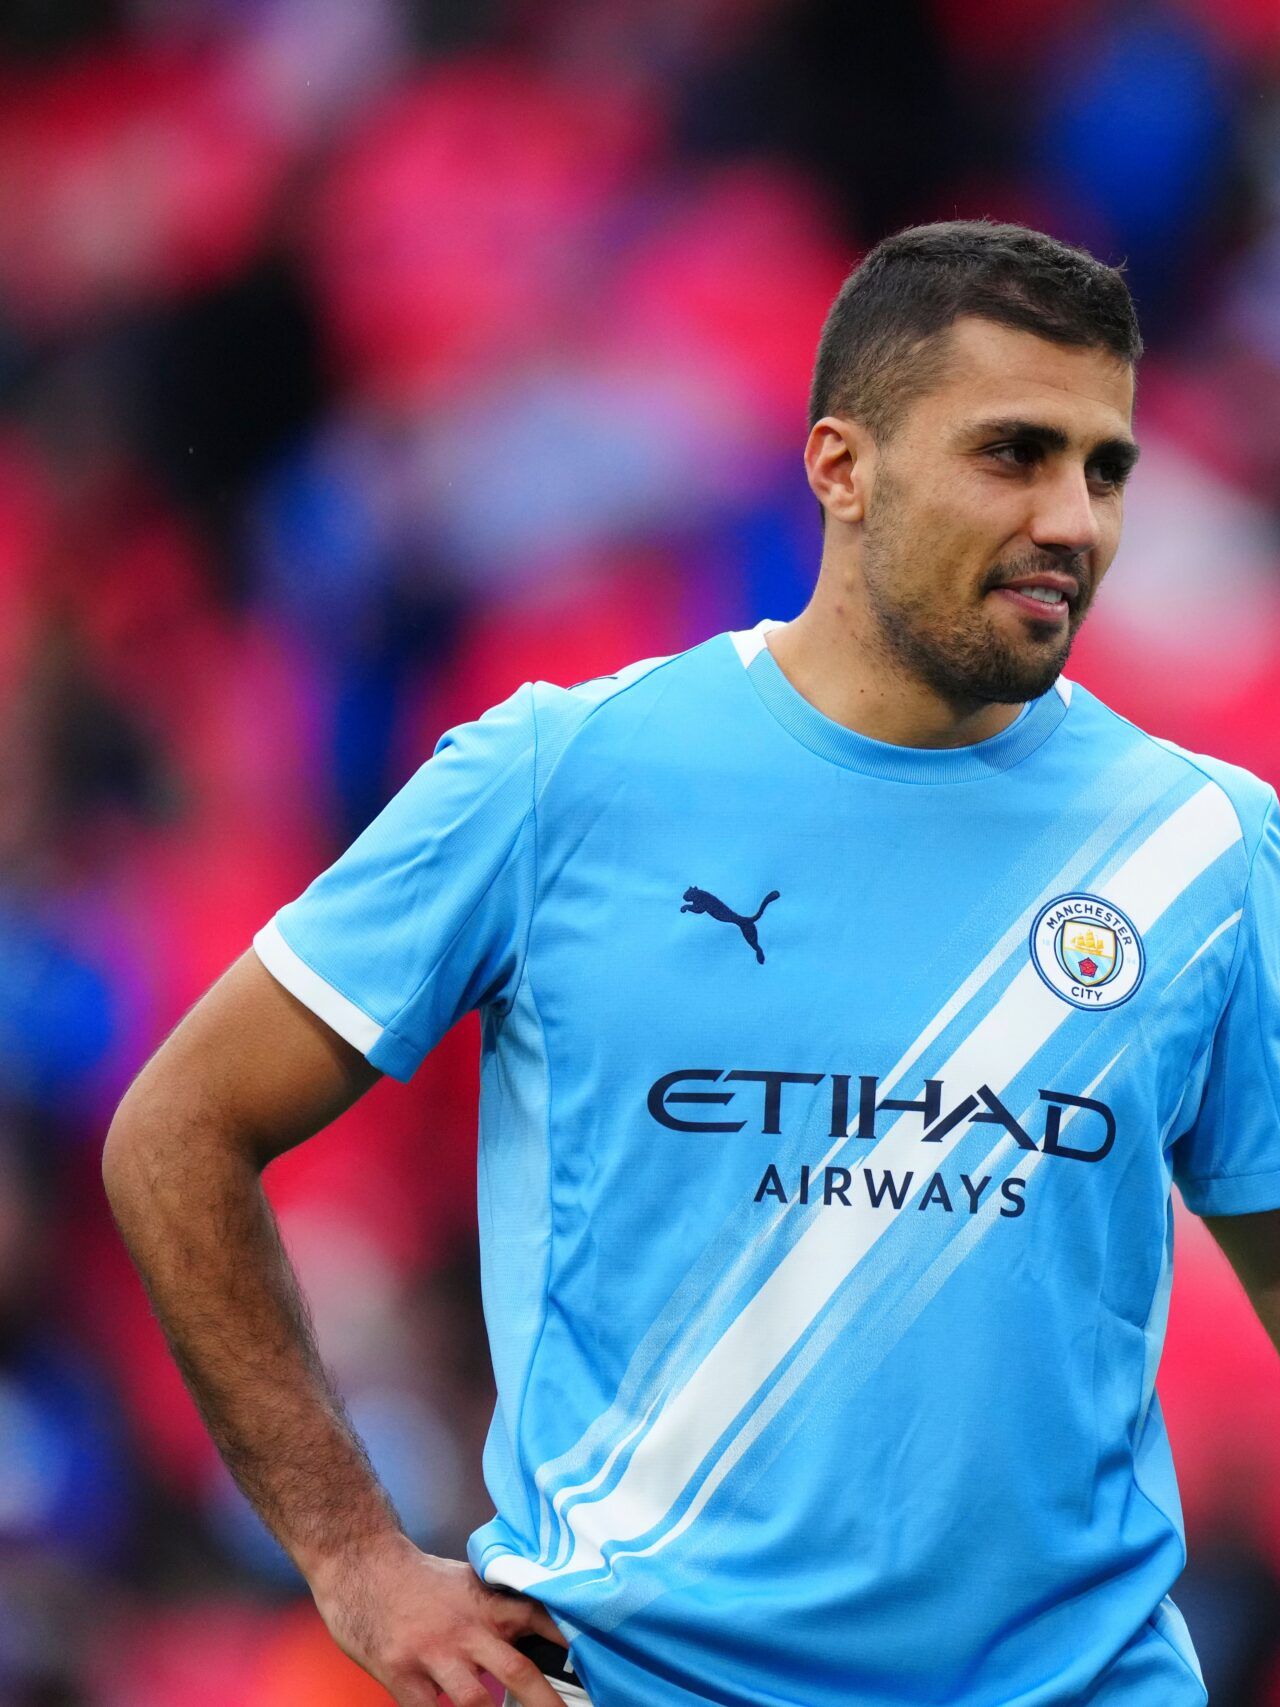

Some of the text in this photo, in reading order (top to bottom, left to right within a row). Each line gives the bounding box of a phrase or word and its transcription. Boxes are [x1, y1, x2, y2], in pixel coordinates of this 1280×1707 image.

[1047, 904, 1132, 945] MANCHESTER
[1071, 987, 1102, 1001] CITY
[647, 1069, 1116, 1162] ETIHAD
[753, 1163, 1026, 1217] AIRWAYS
